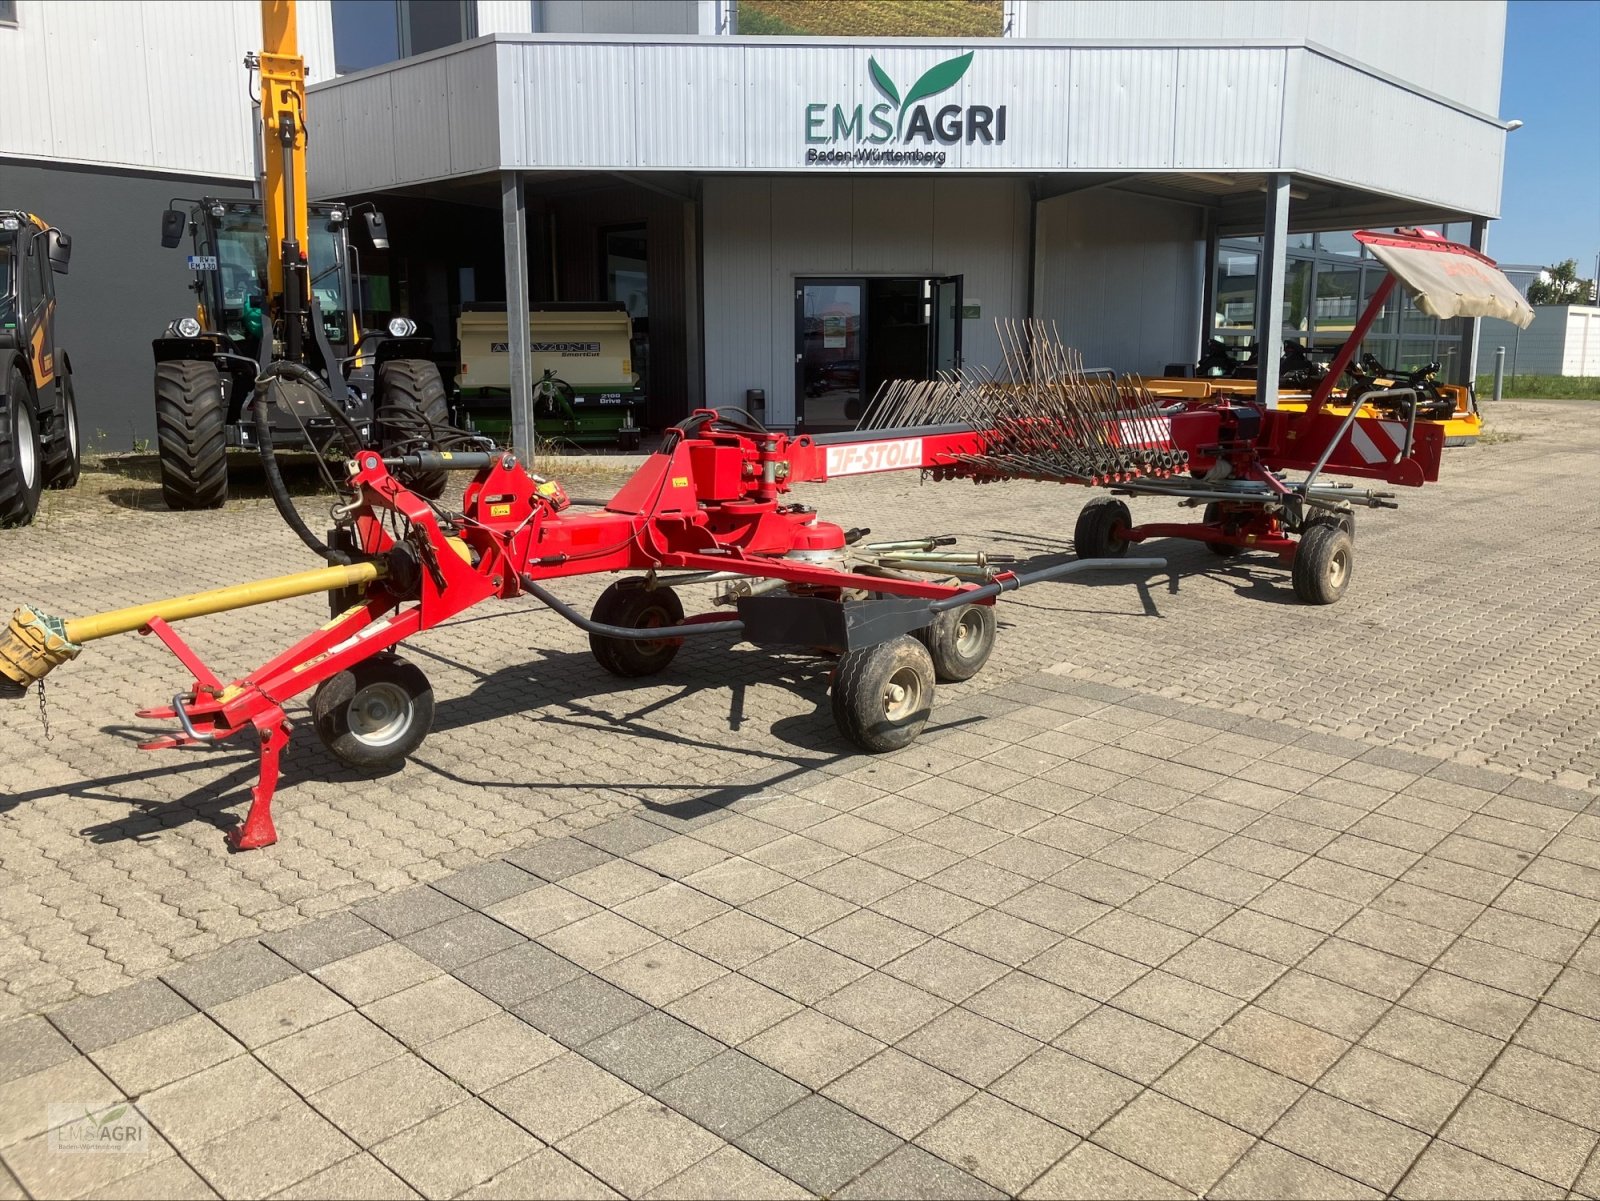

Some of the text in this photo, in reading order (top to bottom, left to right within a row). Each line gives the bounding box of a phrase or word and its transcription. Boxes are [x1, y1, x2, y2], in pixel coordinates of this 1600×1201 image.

[905, 104, 1006, 143] AGRI
[807, 147, 946, 165] Baden-Württemberg
[828, 440, 920, 474] JF-STOLL
